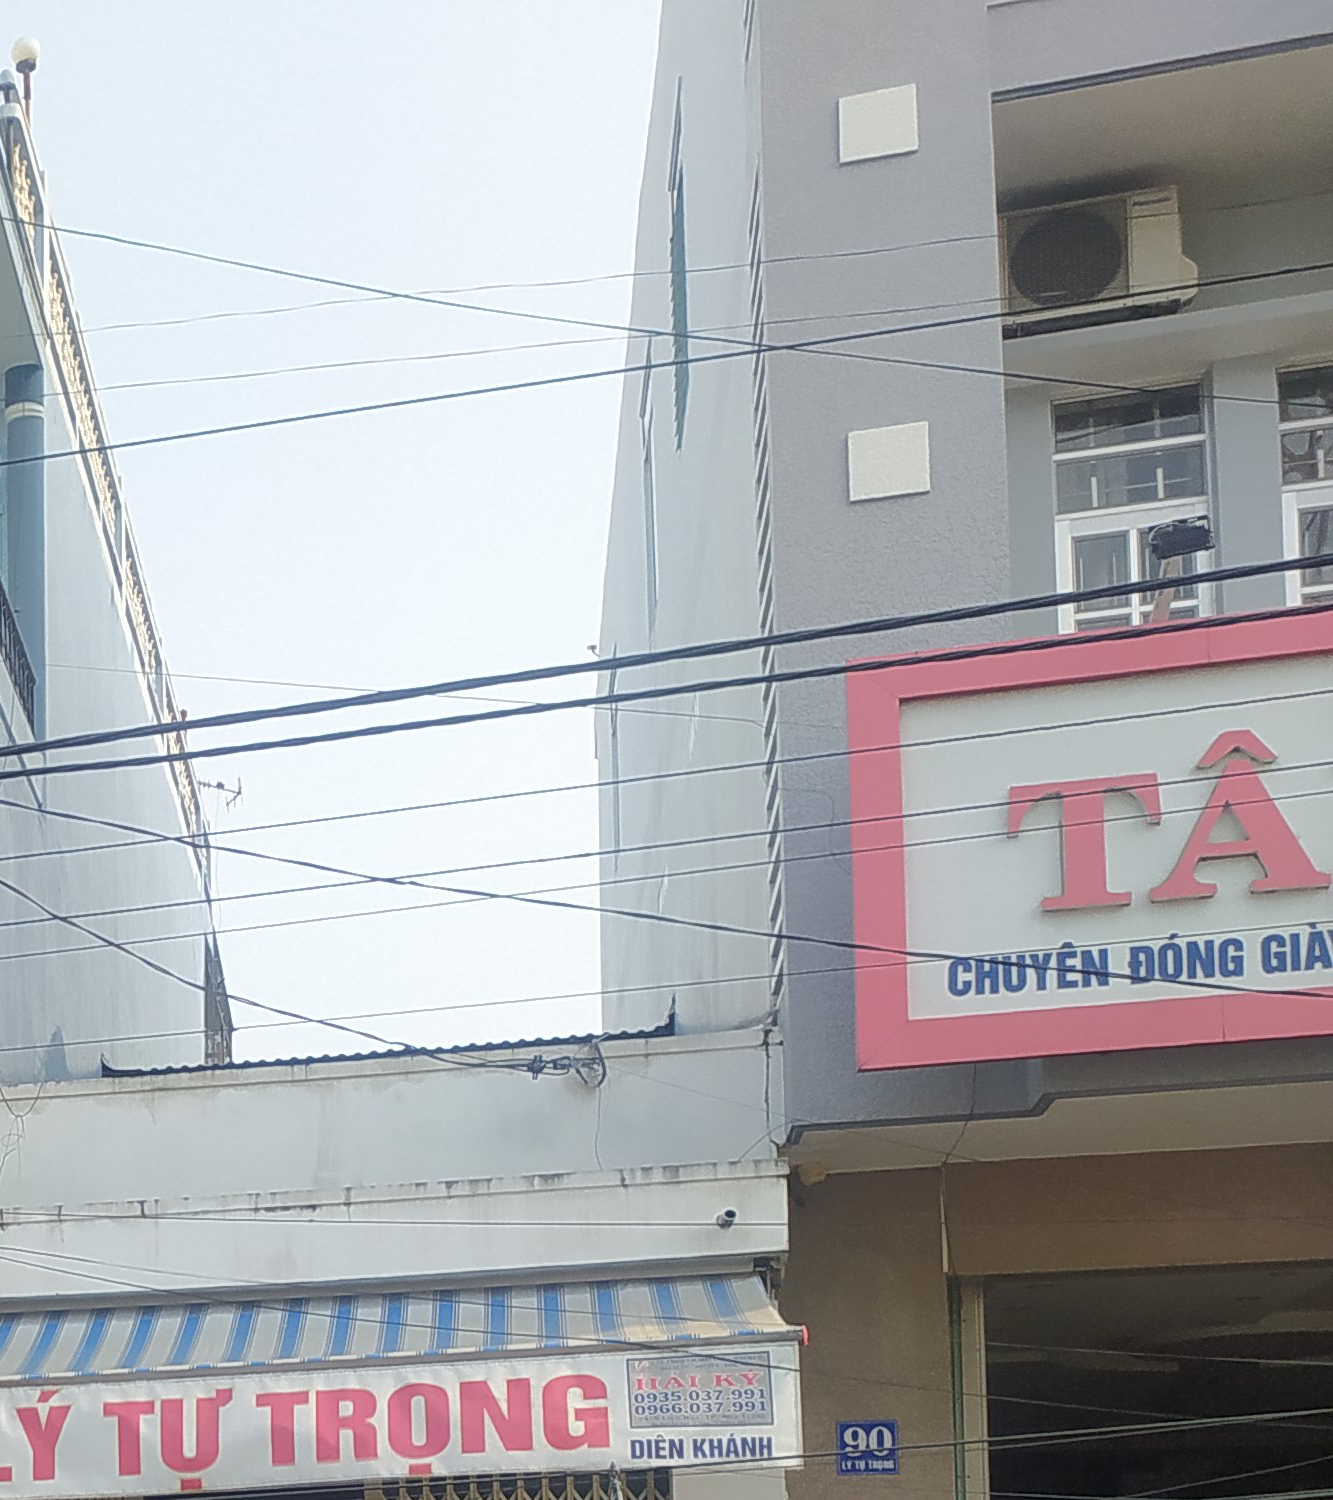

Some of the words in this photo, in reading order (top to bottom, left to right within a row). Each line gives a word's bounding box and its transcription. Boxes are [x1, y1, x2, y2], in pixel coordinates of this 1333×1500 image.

[1006, 729, 1333, 912] TÂ
[947, 941, 1110, 998] CHUYÊN
[1127, 932, 1245, 986] ĐÓNG
[1261, 921, 1333, 975] GIÀ
[634, 1388, 766, 1404] 0935.037.991
[634, 1400, 767, 1416] 0966.037.991
[103, 1388, 231, 1491] TỰ
[255, 1374, 611, 1476] TRỌNG
[630, 1434, 684, 1460] DIÊN
[692, 1433, 773, 1459] KHÁNH
[843, 1426, 893, 1457] 90
